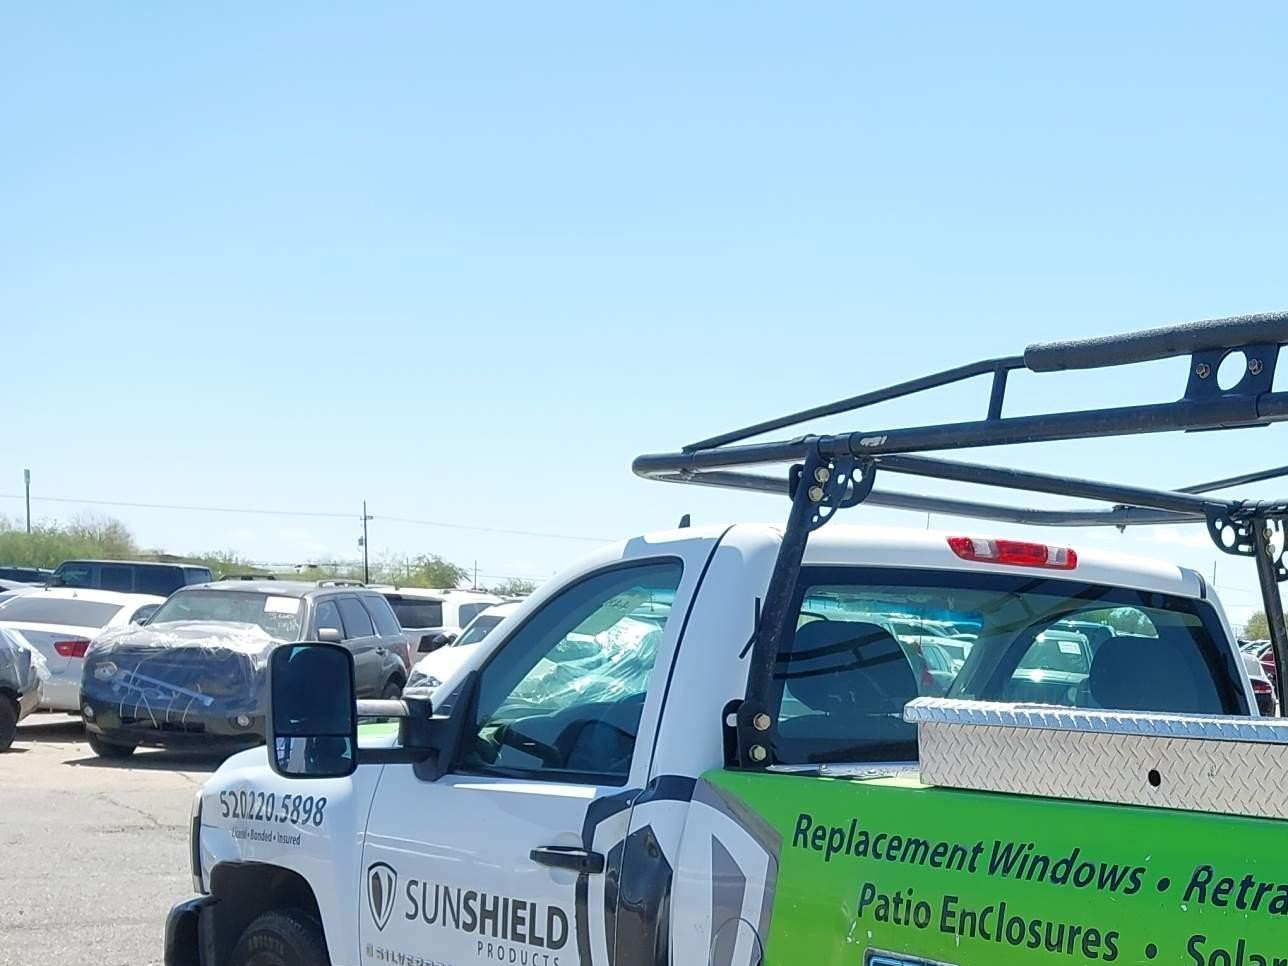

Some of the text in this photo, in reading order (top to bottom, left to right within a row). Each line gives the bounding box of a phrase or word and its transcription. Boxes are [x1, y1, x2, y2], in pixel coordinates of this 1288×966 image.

[250, 829, 272, 843] Bonded
[277, 832, 301, 846] Insured
[792, 813, 985, 874] Replacement
[987, 840, 1146, 895] Windows
[405, 879, 569, 950] SUNSHIELD
[857, 882, 932, 929] Patio
